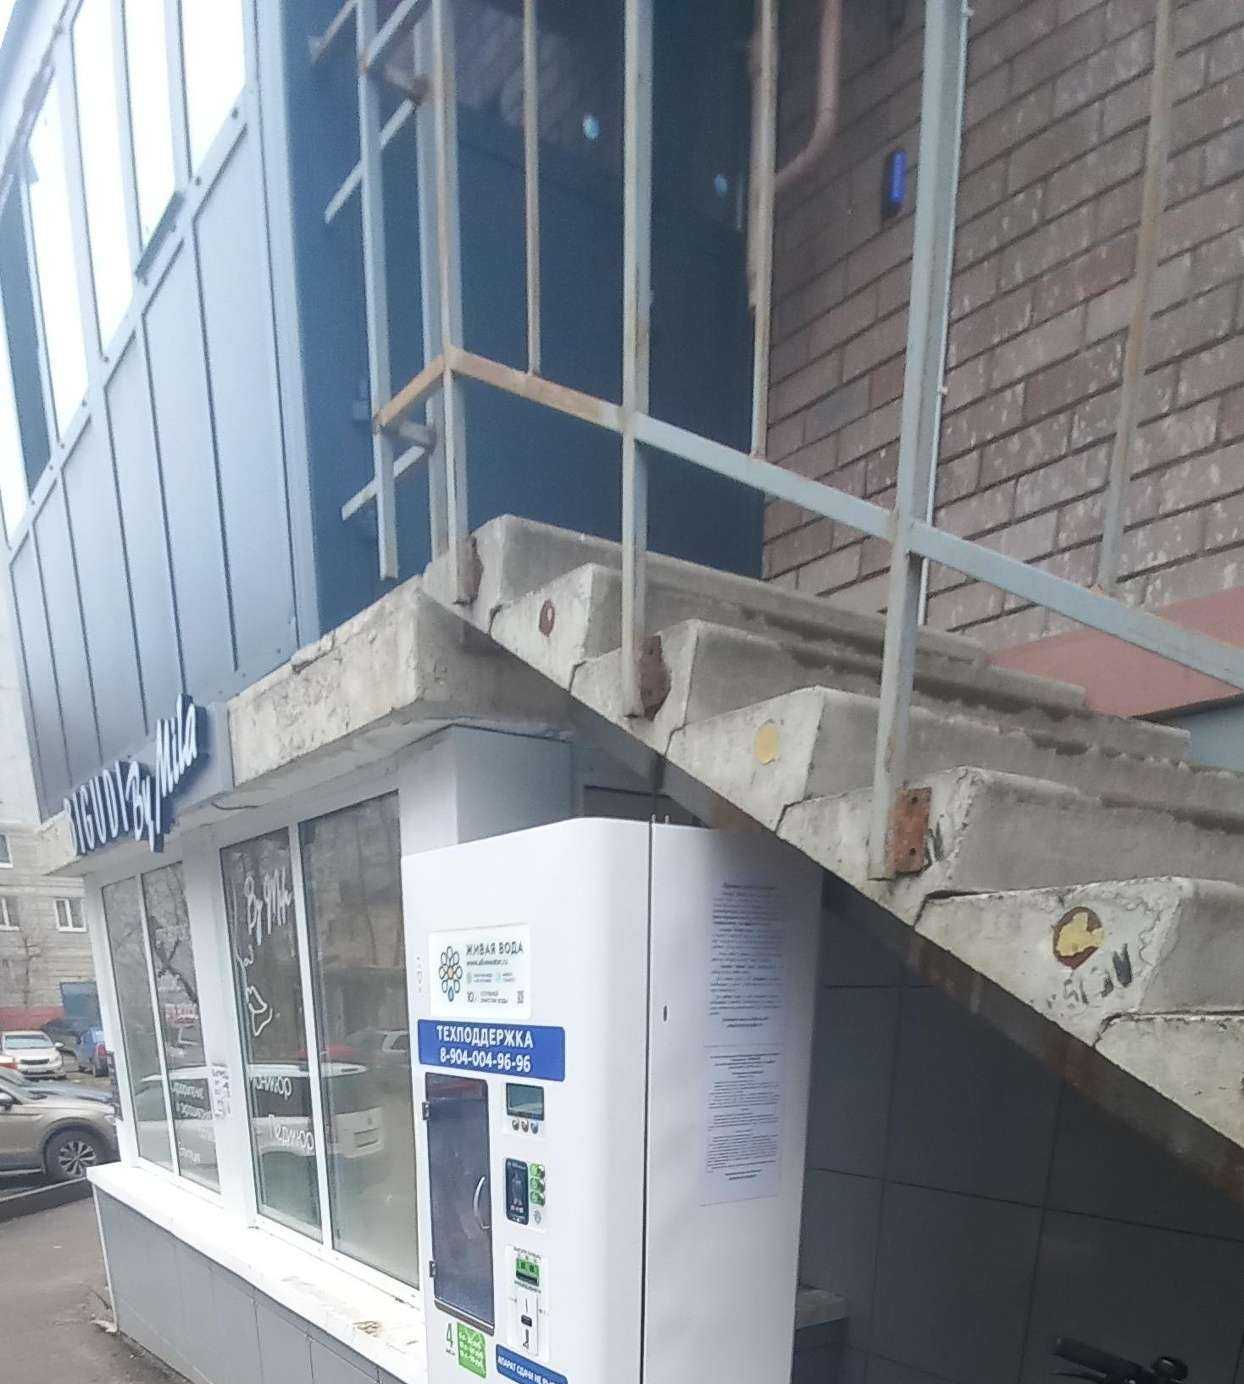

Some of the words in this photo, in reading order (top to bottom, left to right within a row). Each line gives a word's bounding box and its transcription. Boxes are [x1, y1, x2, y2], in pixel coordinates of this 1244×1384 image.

[64, 761, 129, 857] BIGUDI
[126, 761, 155, 853] By
[156, 694, 197, 834] Mila
[466, 943, 496, 956] ЖИВАЯ
[499, 941, 523, 955] ВОДА
[436, 1025, 534, 1049] ТЕХПОДДЕРЖКА
[440, 1046, 531, 1073] 8-904-004-96-96
